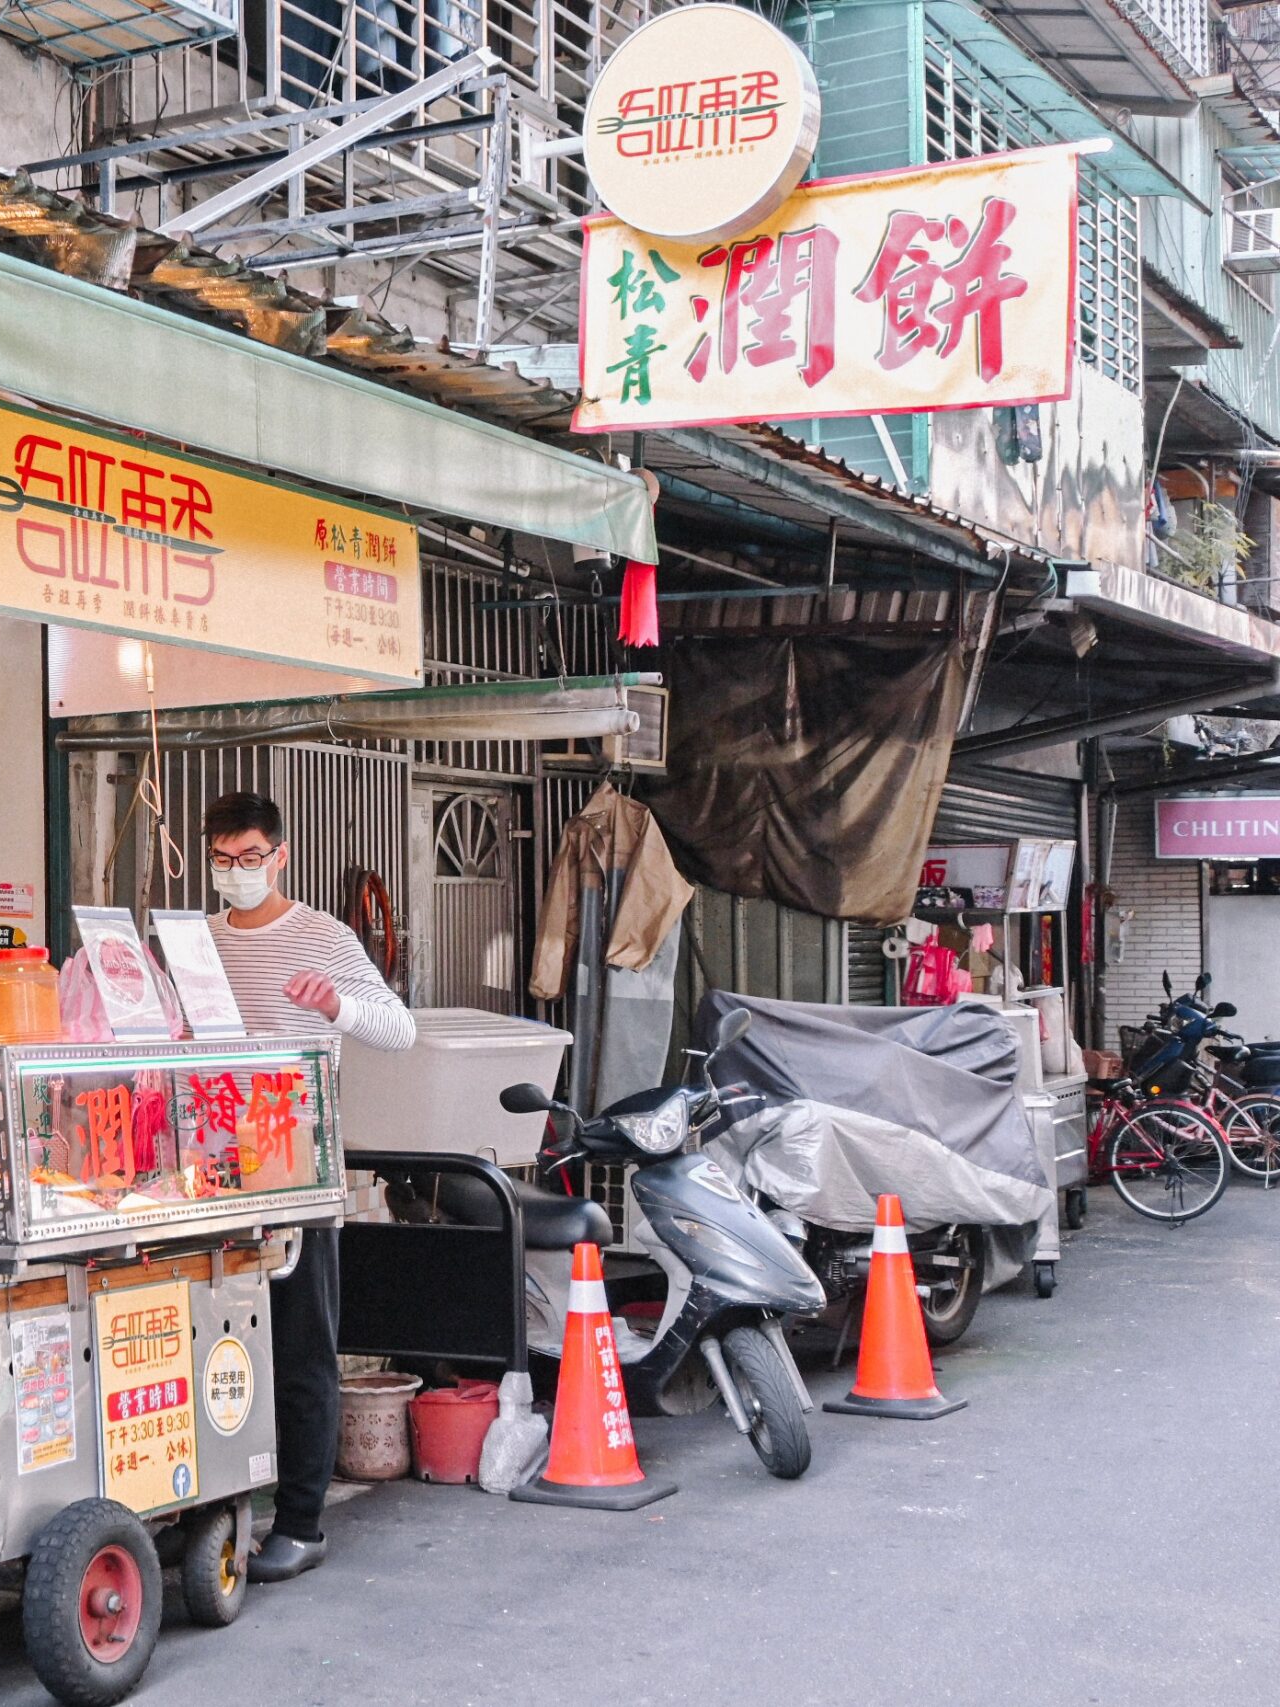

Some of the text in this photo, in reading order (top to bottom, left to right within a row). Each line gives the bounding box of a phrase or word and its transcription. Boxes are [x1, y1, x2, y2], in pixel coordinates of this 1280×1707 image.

[683, 196, 1028, 389] 潤餅
[606, 249, 681, 405] 松青
[314, 518, 398, 567] 原松青潤餅
[334, 564, 390, 601] 營業時間
[117, 1380, 179, 1420] 營業時間
